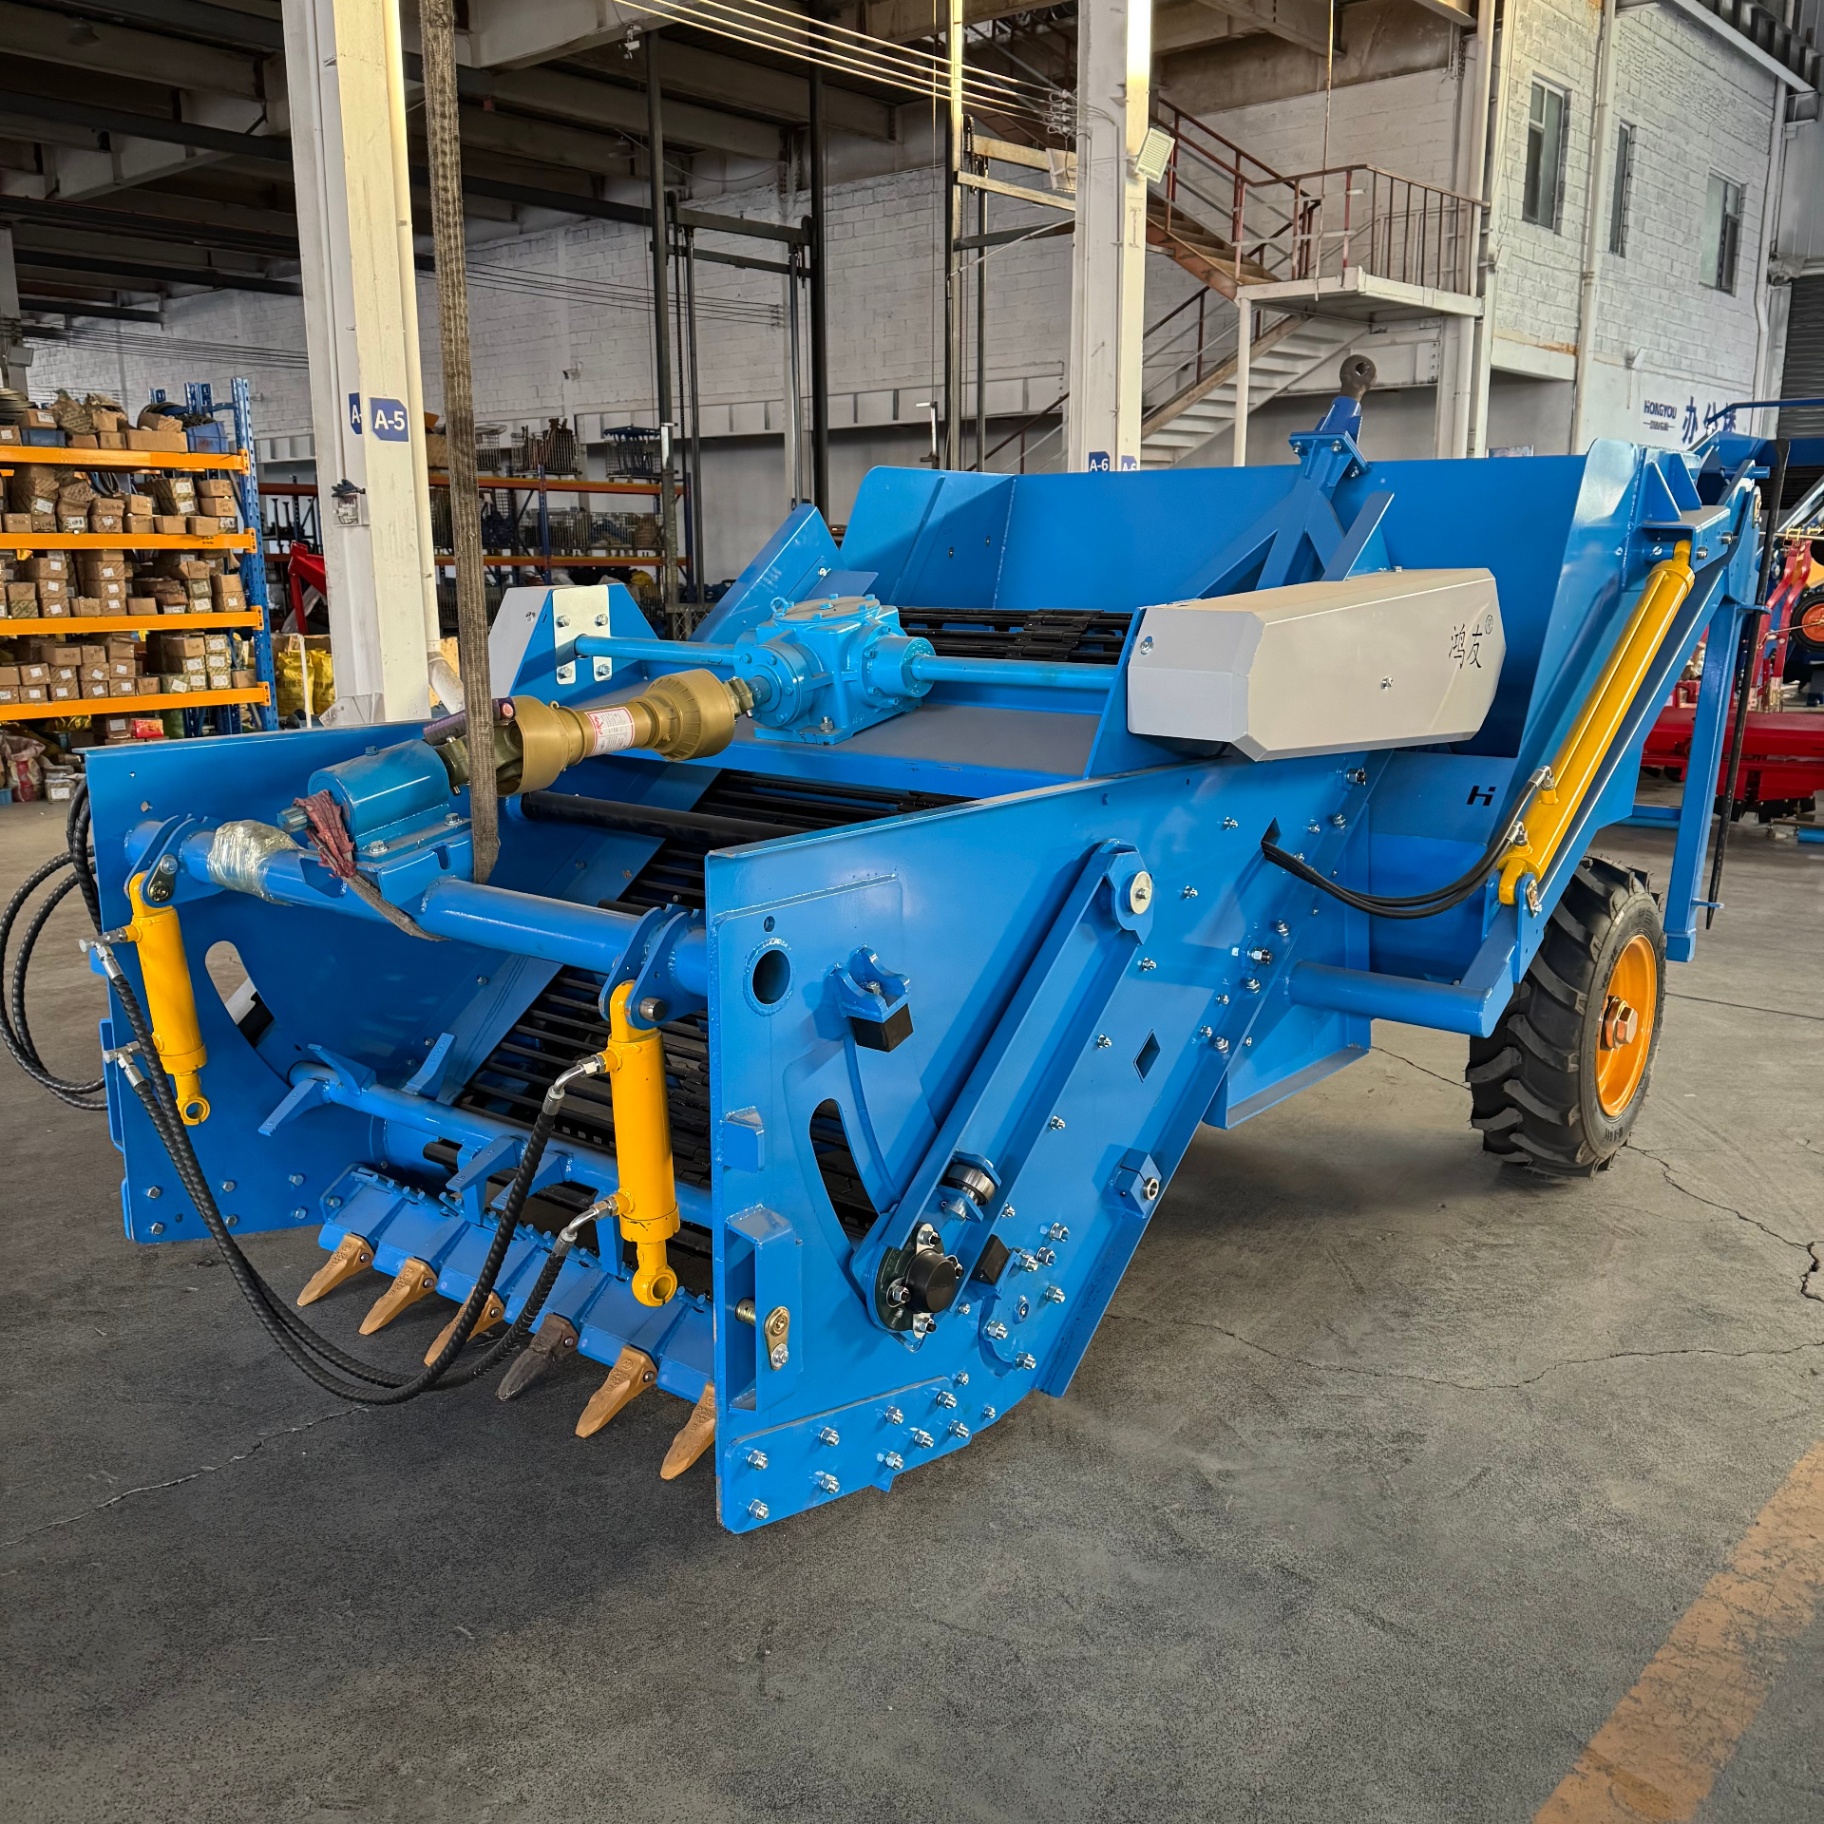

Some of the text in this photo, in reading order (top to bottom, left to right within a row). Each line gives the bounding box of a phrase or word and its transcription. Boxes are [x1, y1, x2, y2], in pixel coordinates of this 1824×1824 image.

[351, 404, 363, 425] A-
[1643, 399, 1678, 419] HONGYOU
[374, 409, 406, 431] A-5
[1089, 458, 1109, 472] A-6
